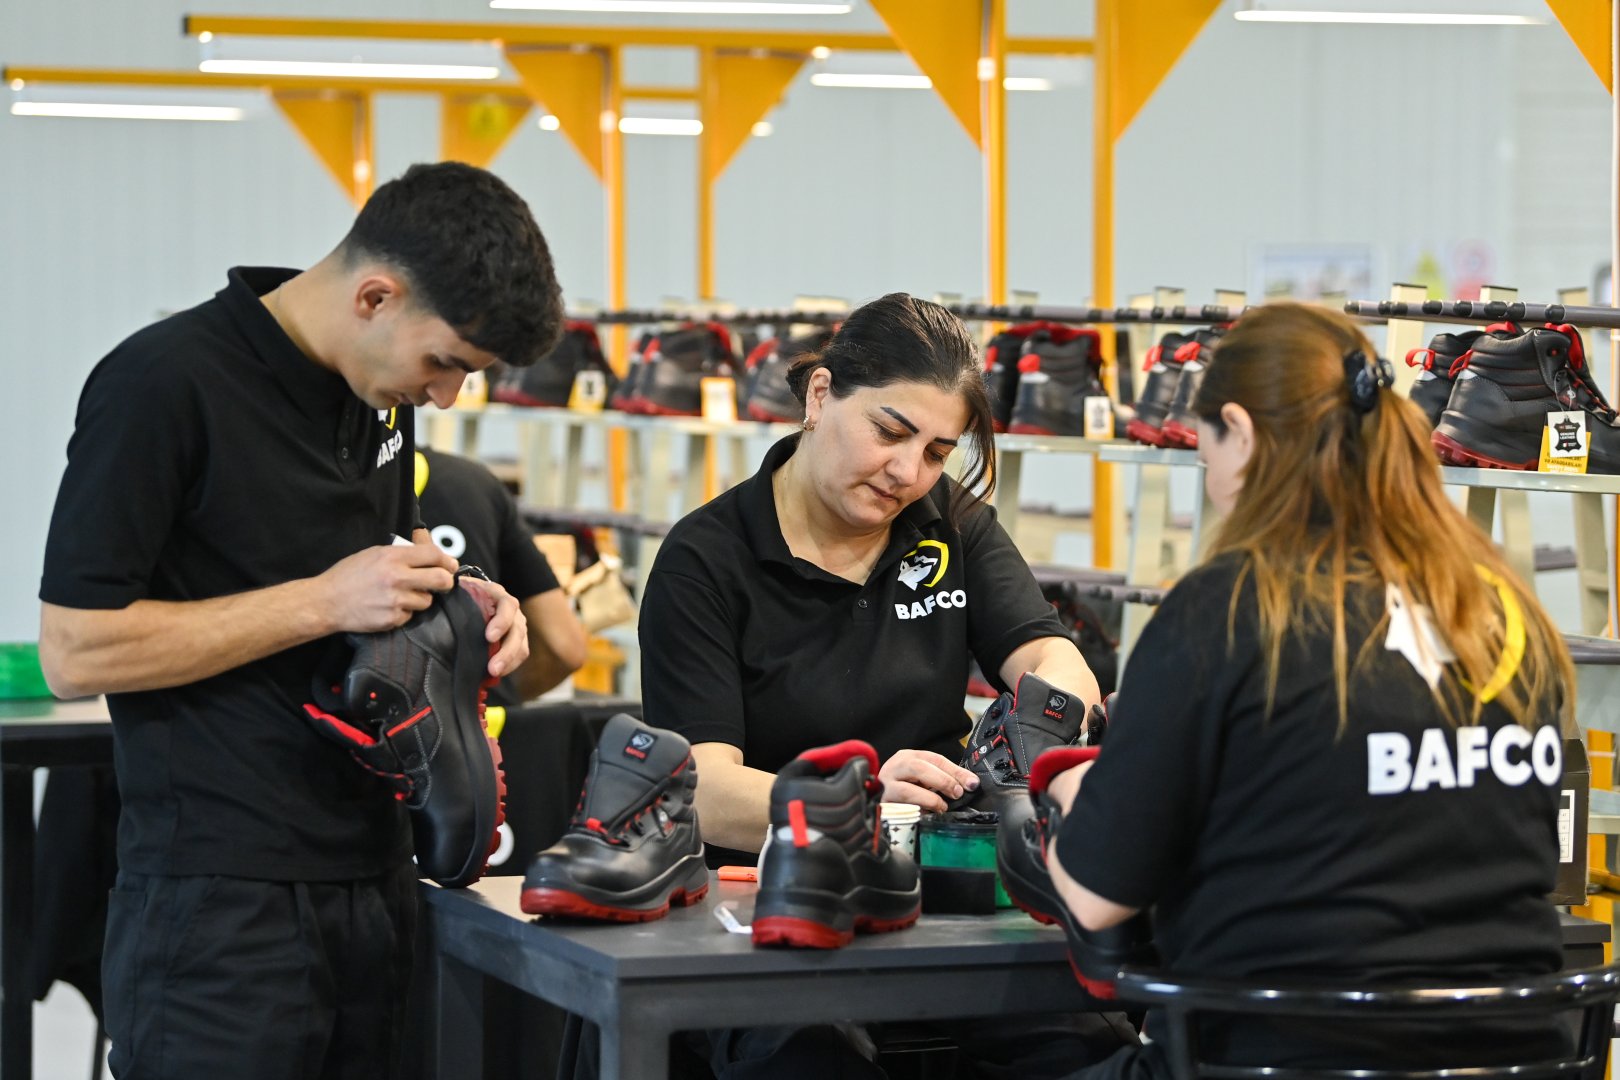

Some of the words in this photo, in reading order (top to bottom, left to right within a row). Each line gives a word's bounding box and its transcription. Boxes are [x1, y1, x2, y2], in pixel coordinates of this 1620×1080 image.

[377, 429, 403, 469] AFO
[894, 589, 967, 620] BAFCO
[1044, 709, 1063, 719] BAFCO
[1366, 724, 1562, 795] BAFCO
